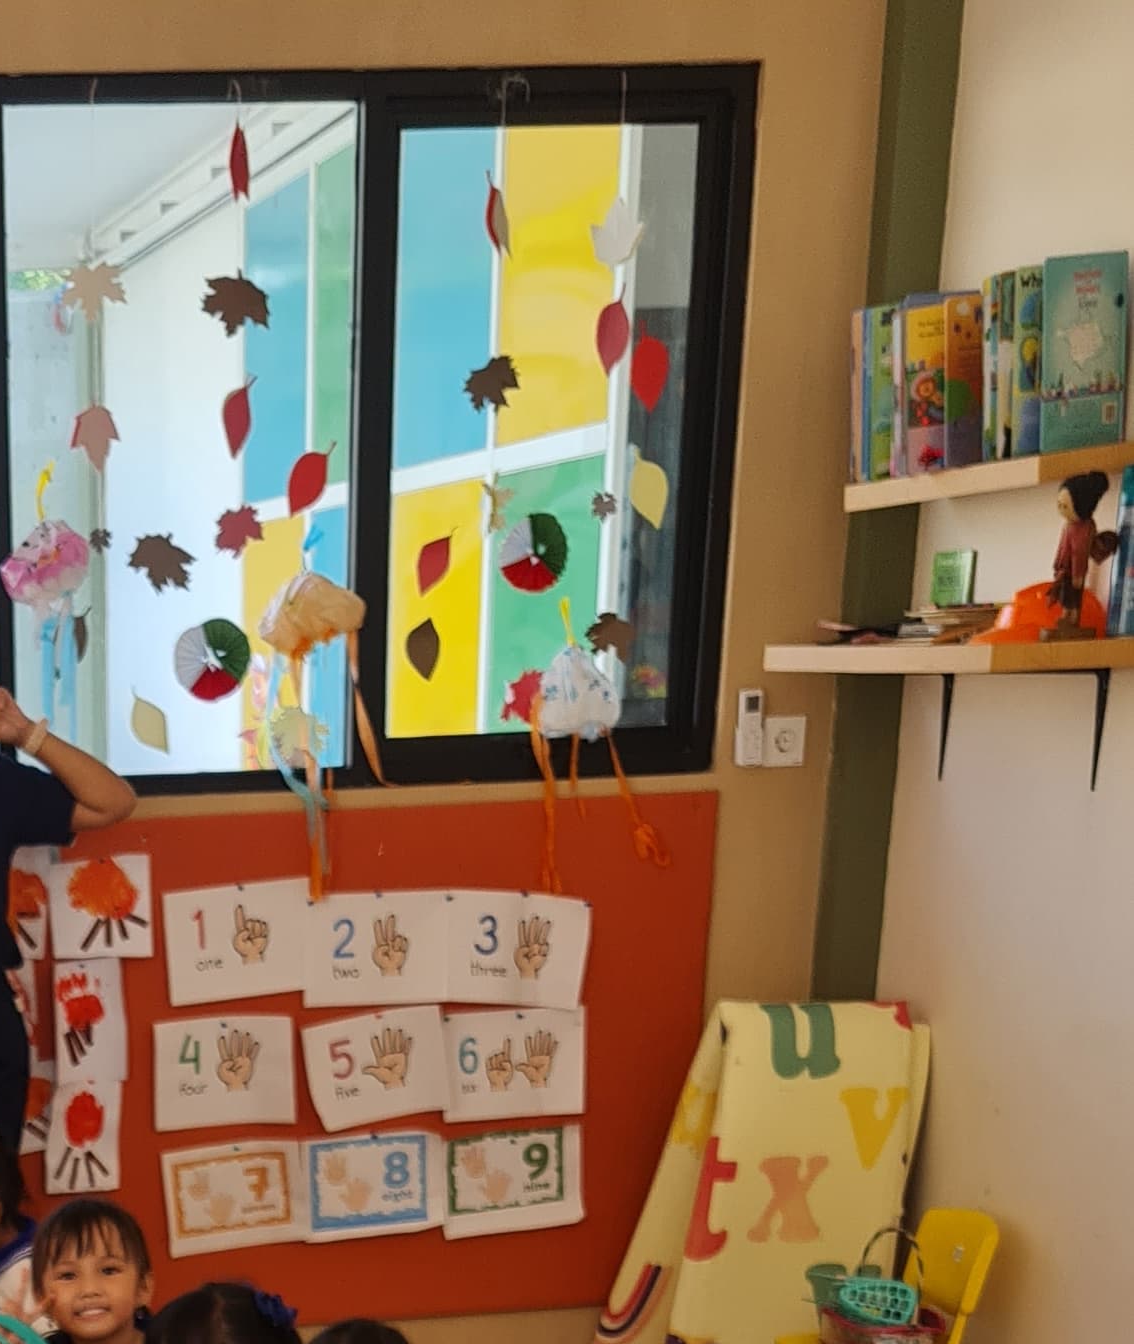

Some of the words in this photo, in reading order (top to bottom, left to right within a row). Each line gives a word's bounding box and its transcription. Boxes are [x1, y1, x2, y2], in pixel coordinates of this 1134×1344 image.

[192, 909, 206, 950] 1
[332, 918, 355, 959] 2
[474, 915, 498, 955] 3
[195, 959, 224, 972] one
[333, 966, 360, 980] two
[470, 960, 508, 978] three
[178, 1034, 201, 1075] 4
[328, 1039, 354, 1080] 5
[458, 1036, 479, 1075] 6
[383, 1151, 410, 1189] 8
[522, 1142, 550, 1181] 9
[242, 1166, 271, 1202] 7
